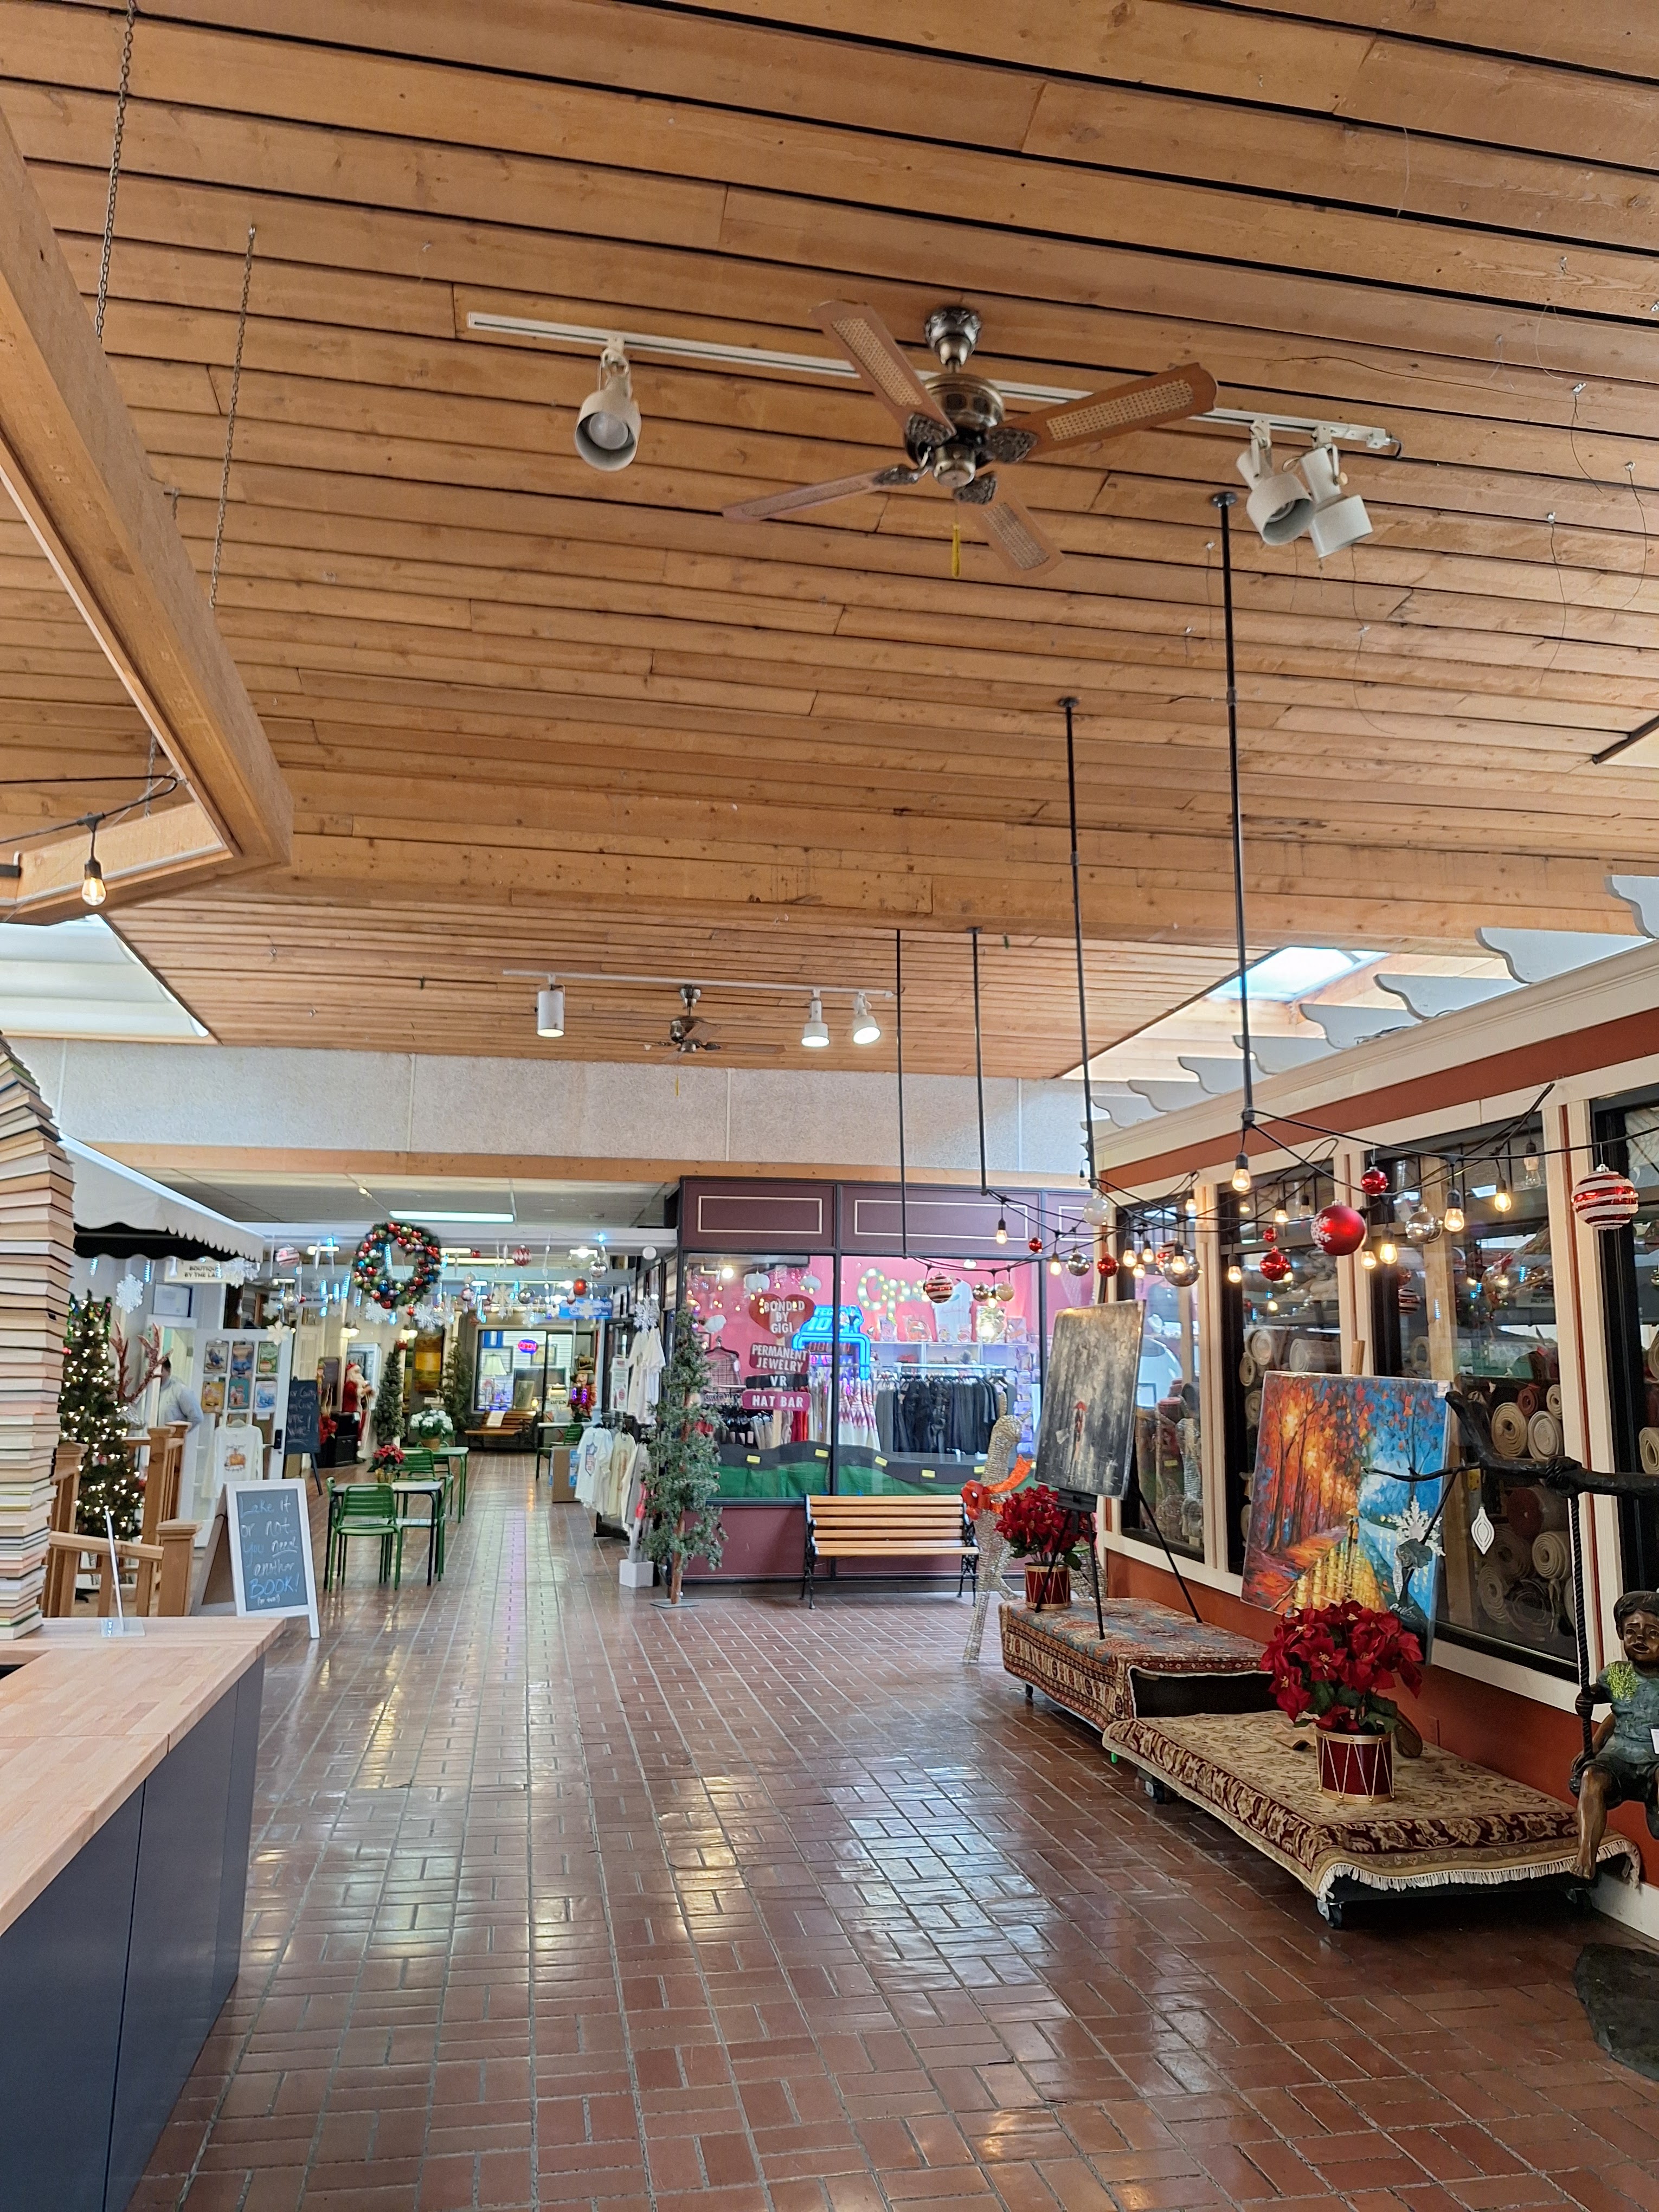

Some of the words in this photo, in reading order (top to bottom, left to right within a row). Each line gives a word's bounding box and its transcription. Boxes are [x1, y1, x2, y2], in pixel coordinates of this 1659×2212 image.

[857, 1268, 932, 1319] Ope
[776, 1311, 789, 1322] BY
[771, 1322, 793, 1334] GIGI
[751, 1344, 808, 1361] PERMANENT
[756, 1356, 803, 1373] JEWELRY
[770, 1375, 787, 1386] VR
[752, 1395, 776, 1407] HAT
[780, 1396, 803, 1408] BAR
[240, 1522, 255, 1537] or
[249, 1573, 300, 1599] BOOK!
